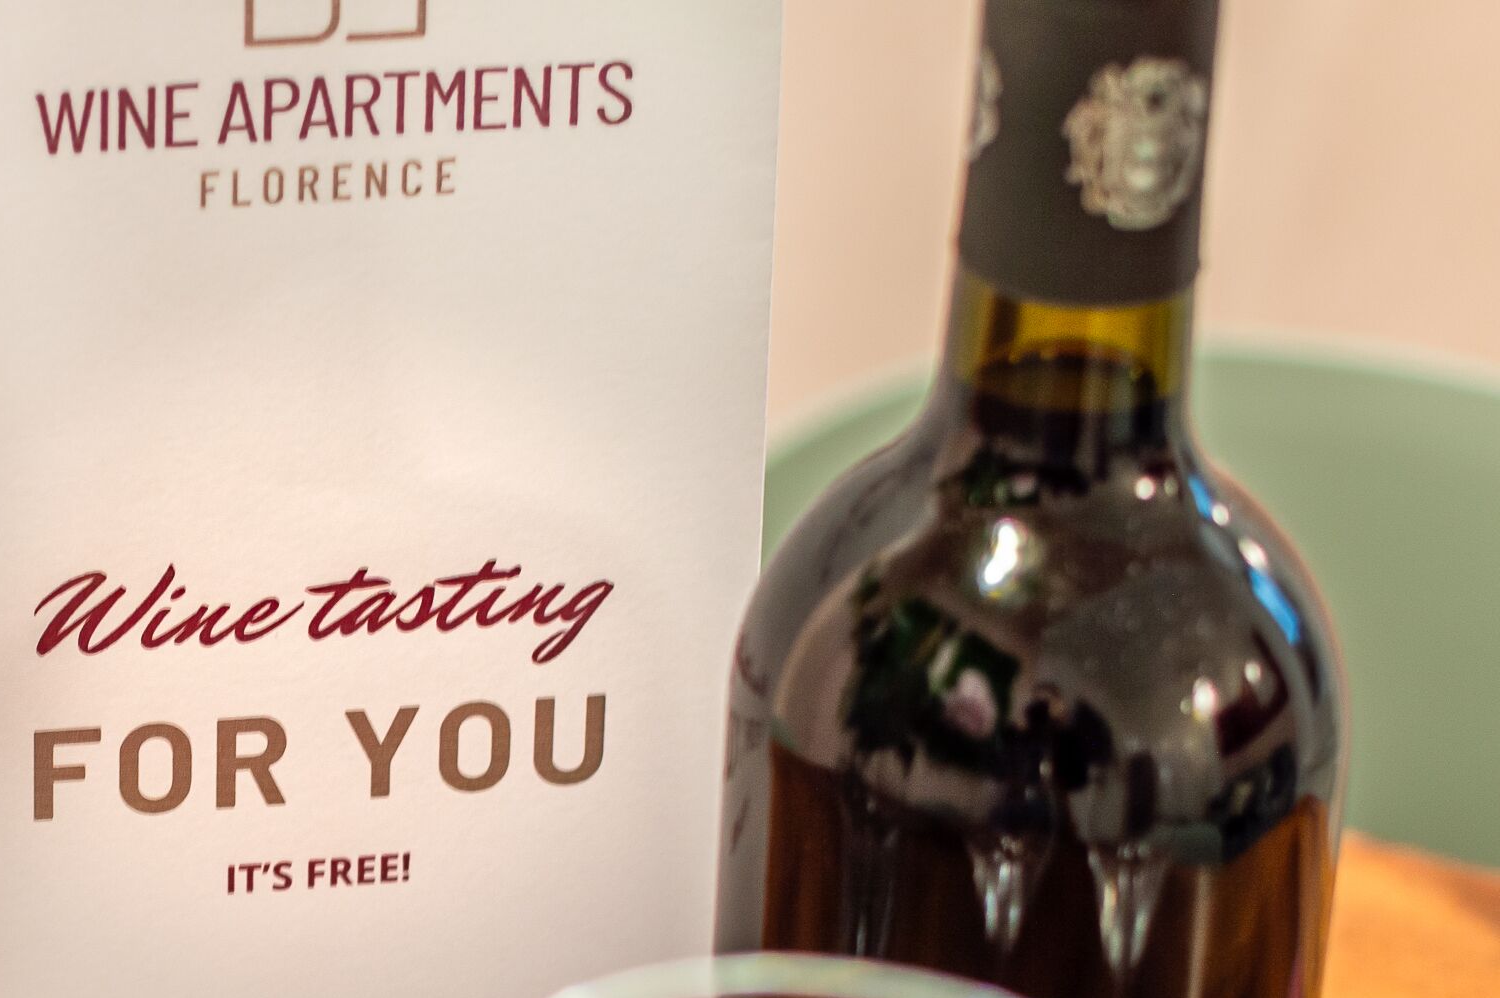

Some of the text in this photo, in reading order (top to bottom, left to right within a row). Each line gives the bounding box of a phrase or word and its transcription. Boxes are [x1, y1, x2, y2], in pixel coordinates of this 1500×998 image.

[35, 60, 634, 155] WINE APARTMENTS
[199, 156, 458, 210] FLORENCE
[33, 558, 615, 664] Wine tasting
[33, 692, 607, 822] FOR YOU
[226, 852, 412, 895] IT'S FREE!
